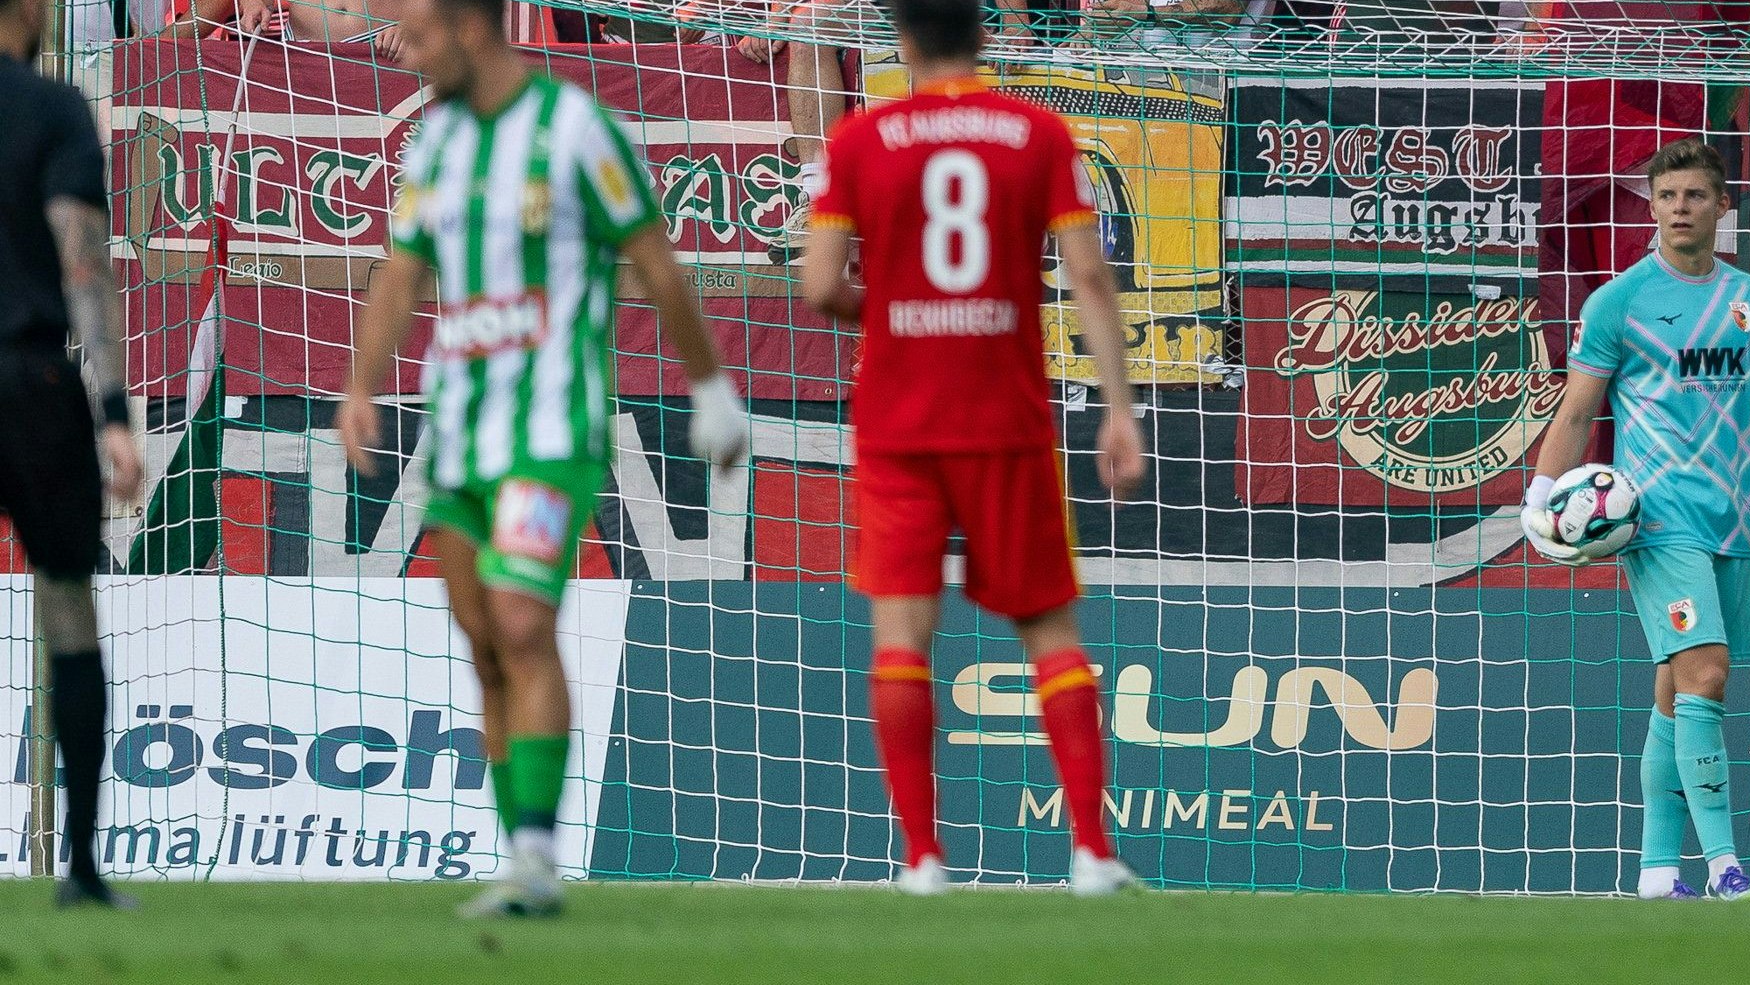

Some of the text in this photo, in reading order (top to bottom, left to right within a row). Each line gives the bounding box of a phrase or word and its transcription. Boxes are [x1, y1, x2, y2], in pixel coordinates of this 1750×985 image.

[921, 147, 992, 296] 8
[1349, 191, 1541, 256] Augsb
[227, 256, 282, 281] Legio
[1273, 292, 1543, 377] Dissiden
[1677, 346, 1747, 378] WWK
[1369, 444, 1509, 487] ARE UNITED
[947, 662, 1438, 749] SUN
[1696, 754, 1721, 766] FCA
[1017, 787, 1334, 831] MNIMEAL
